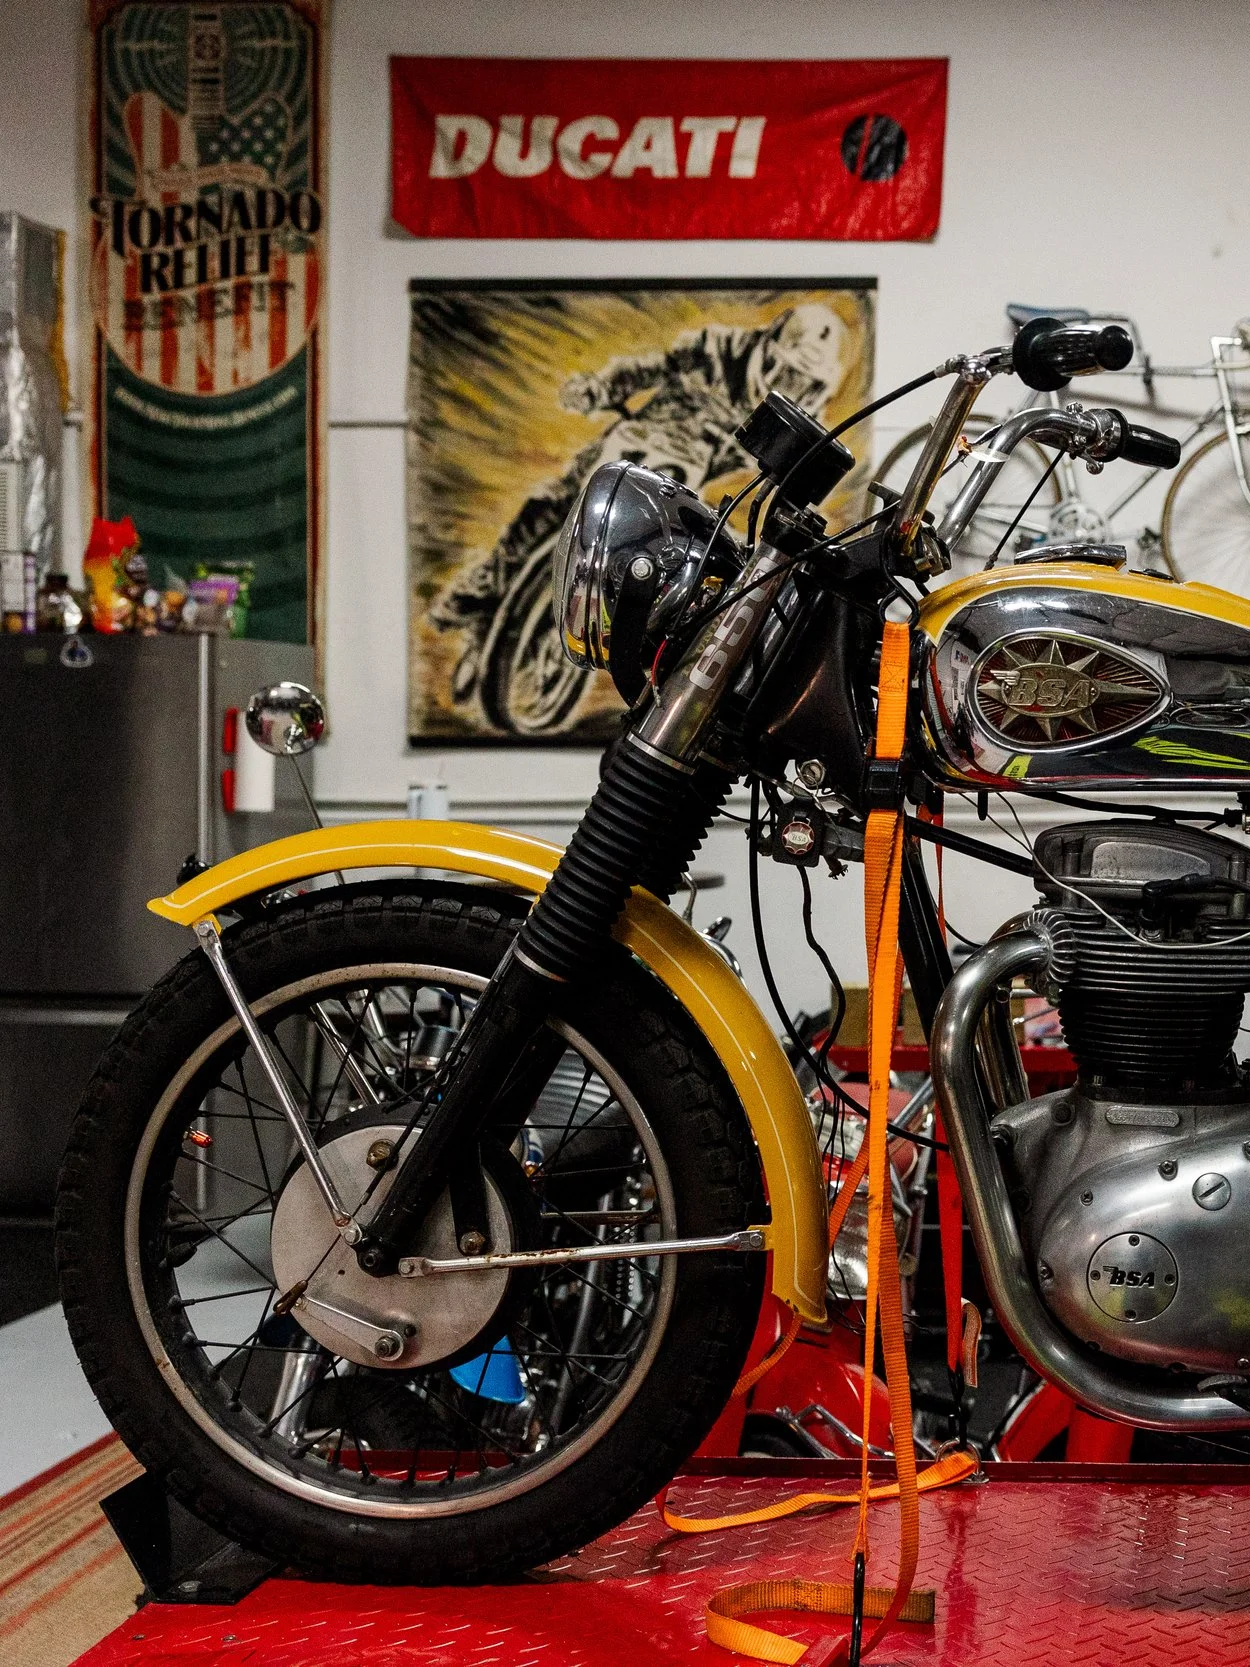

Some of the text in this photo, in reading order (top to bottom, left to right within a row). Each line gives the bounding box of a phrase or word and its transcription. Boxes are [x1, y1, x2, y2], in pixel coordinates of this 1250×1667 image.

[428, 114, 767, 179] DUCATI
[92, 188, 321, 258] TORNADO
[140, 232, 270, 293] RELIEF
[689, 556, 779, 690] 650
[1008, 678, 1091, 708] BSA
[792, 833, 807, 843] BSA
[1109, 1270, 1155, 1288] BSA
